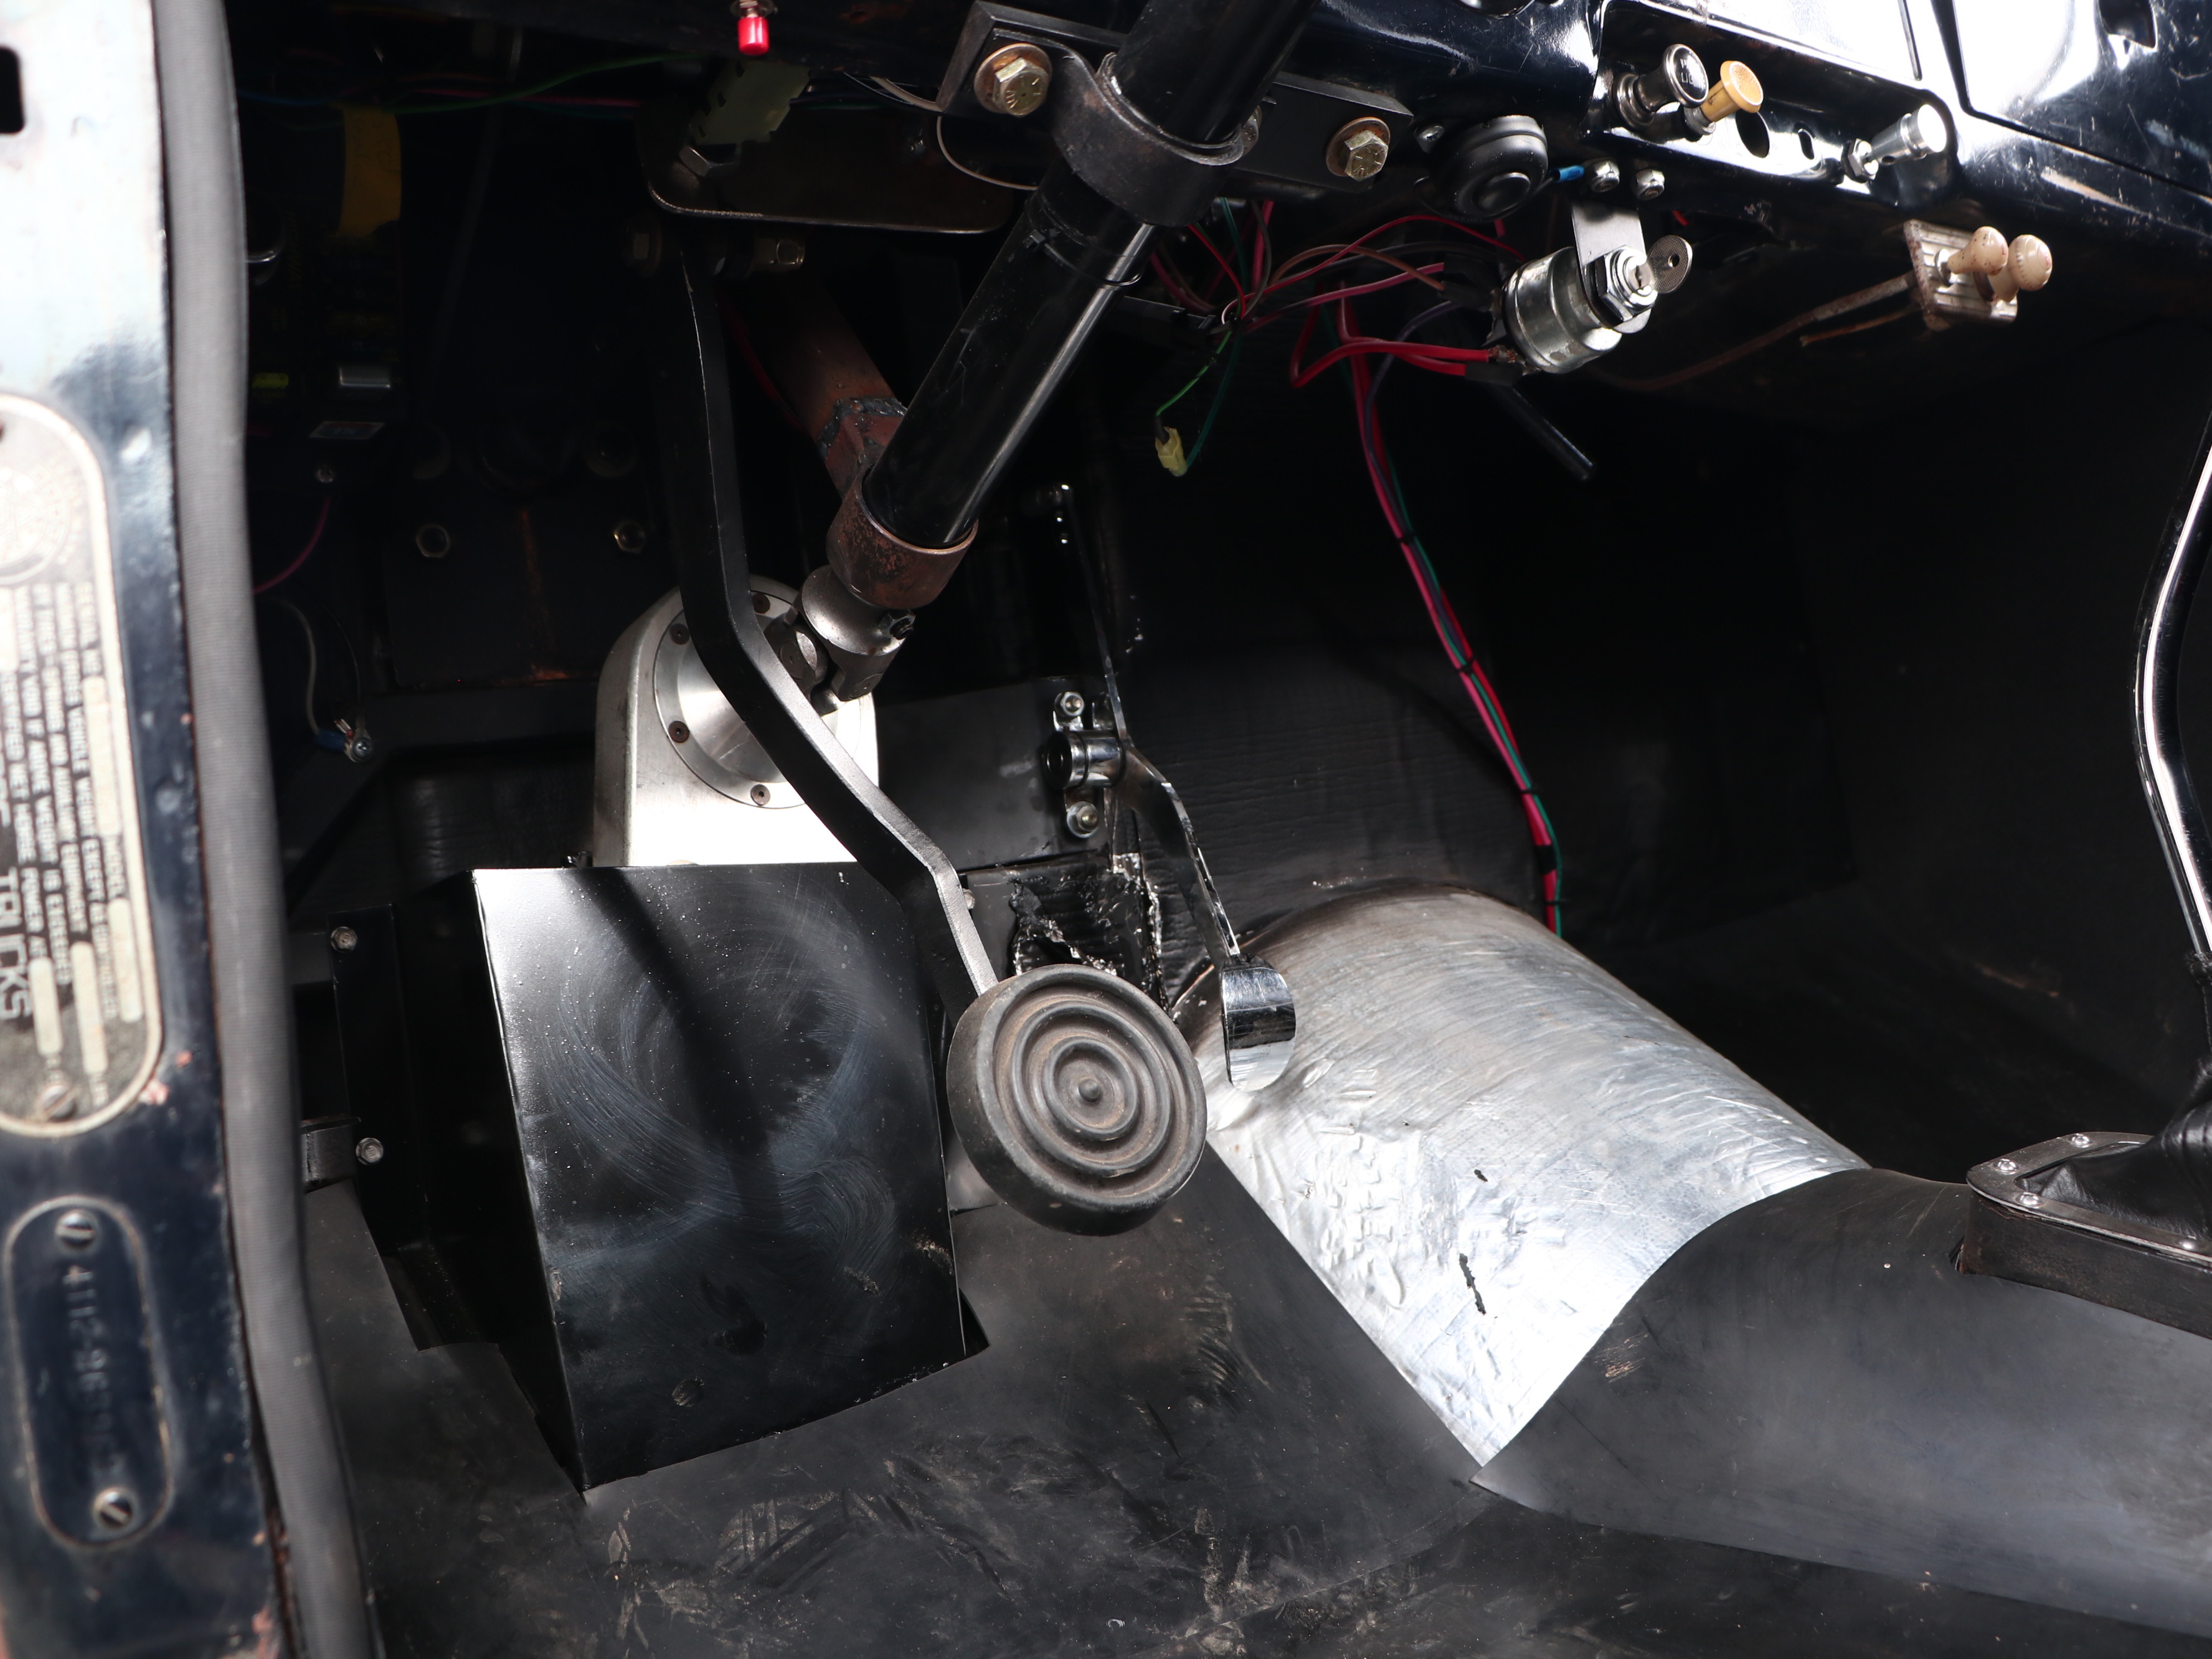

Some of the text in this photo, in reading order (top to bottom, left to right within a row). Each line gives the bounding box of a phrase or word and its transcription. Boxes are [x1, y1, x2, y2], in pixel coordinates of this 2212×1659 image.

[19, 674, 42, 717] VOID
[24, 718, 45, 739] IF
[67, 706, 90, 773] VEHICLE
[7, 762, 30, 800] NET
[26, 739, 51, 794] ABOVE
[12, 803, 37, 864] HORSE
[32, 795, 59, 864] WEIGHT
[47, 732, 69, 766] AND
[59, 843, 88, 933] EQUIPMENT
[74, 777, 97, 838] WEIGHT
[41, 868, 62, 891] IS
[82, 838, 105, 904] EXCEPT
[102, 836, 126, 899] MODEL
[19, 866, 45, 933] POWER
[0, 866, 32, 1020] TRUCKS
[27, 934, 48, 958] AT
[44, 893, 73, 986] EXCEEDED
